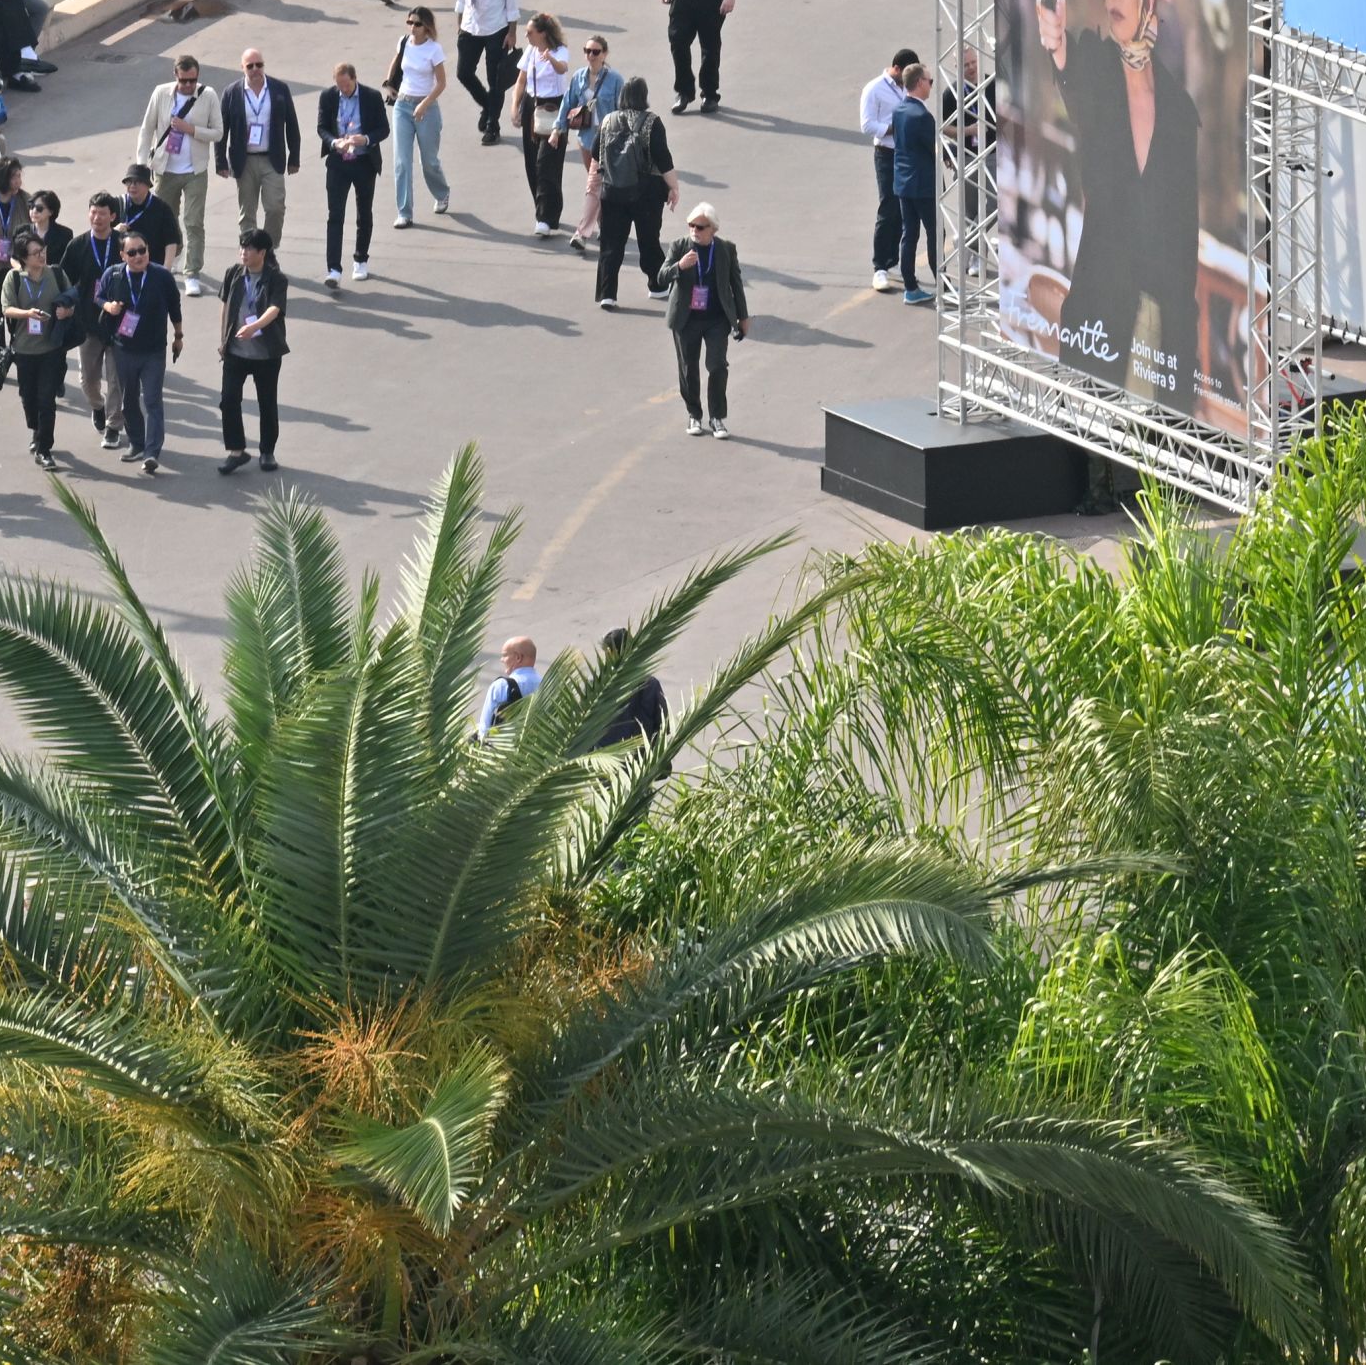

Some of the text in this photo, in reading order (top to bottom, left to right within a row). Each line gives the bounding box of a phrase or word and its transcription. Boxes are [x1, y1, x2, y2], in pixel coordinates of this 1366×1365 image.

[1005, 289, 1119, 362] Fremantle
[1131, 337, 1178, 371] Join us at
[1133, 361, 1176, 392] Riviera 9
[1193, 369, 1222, 389] Access to
